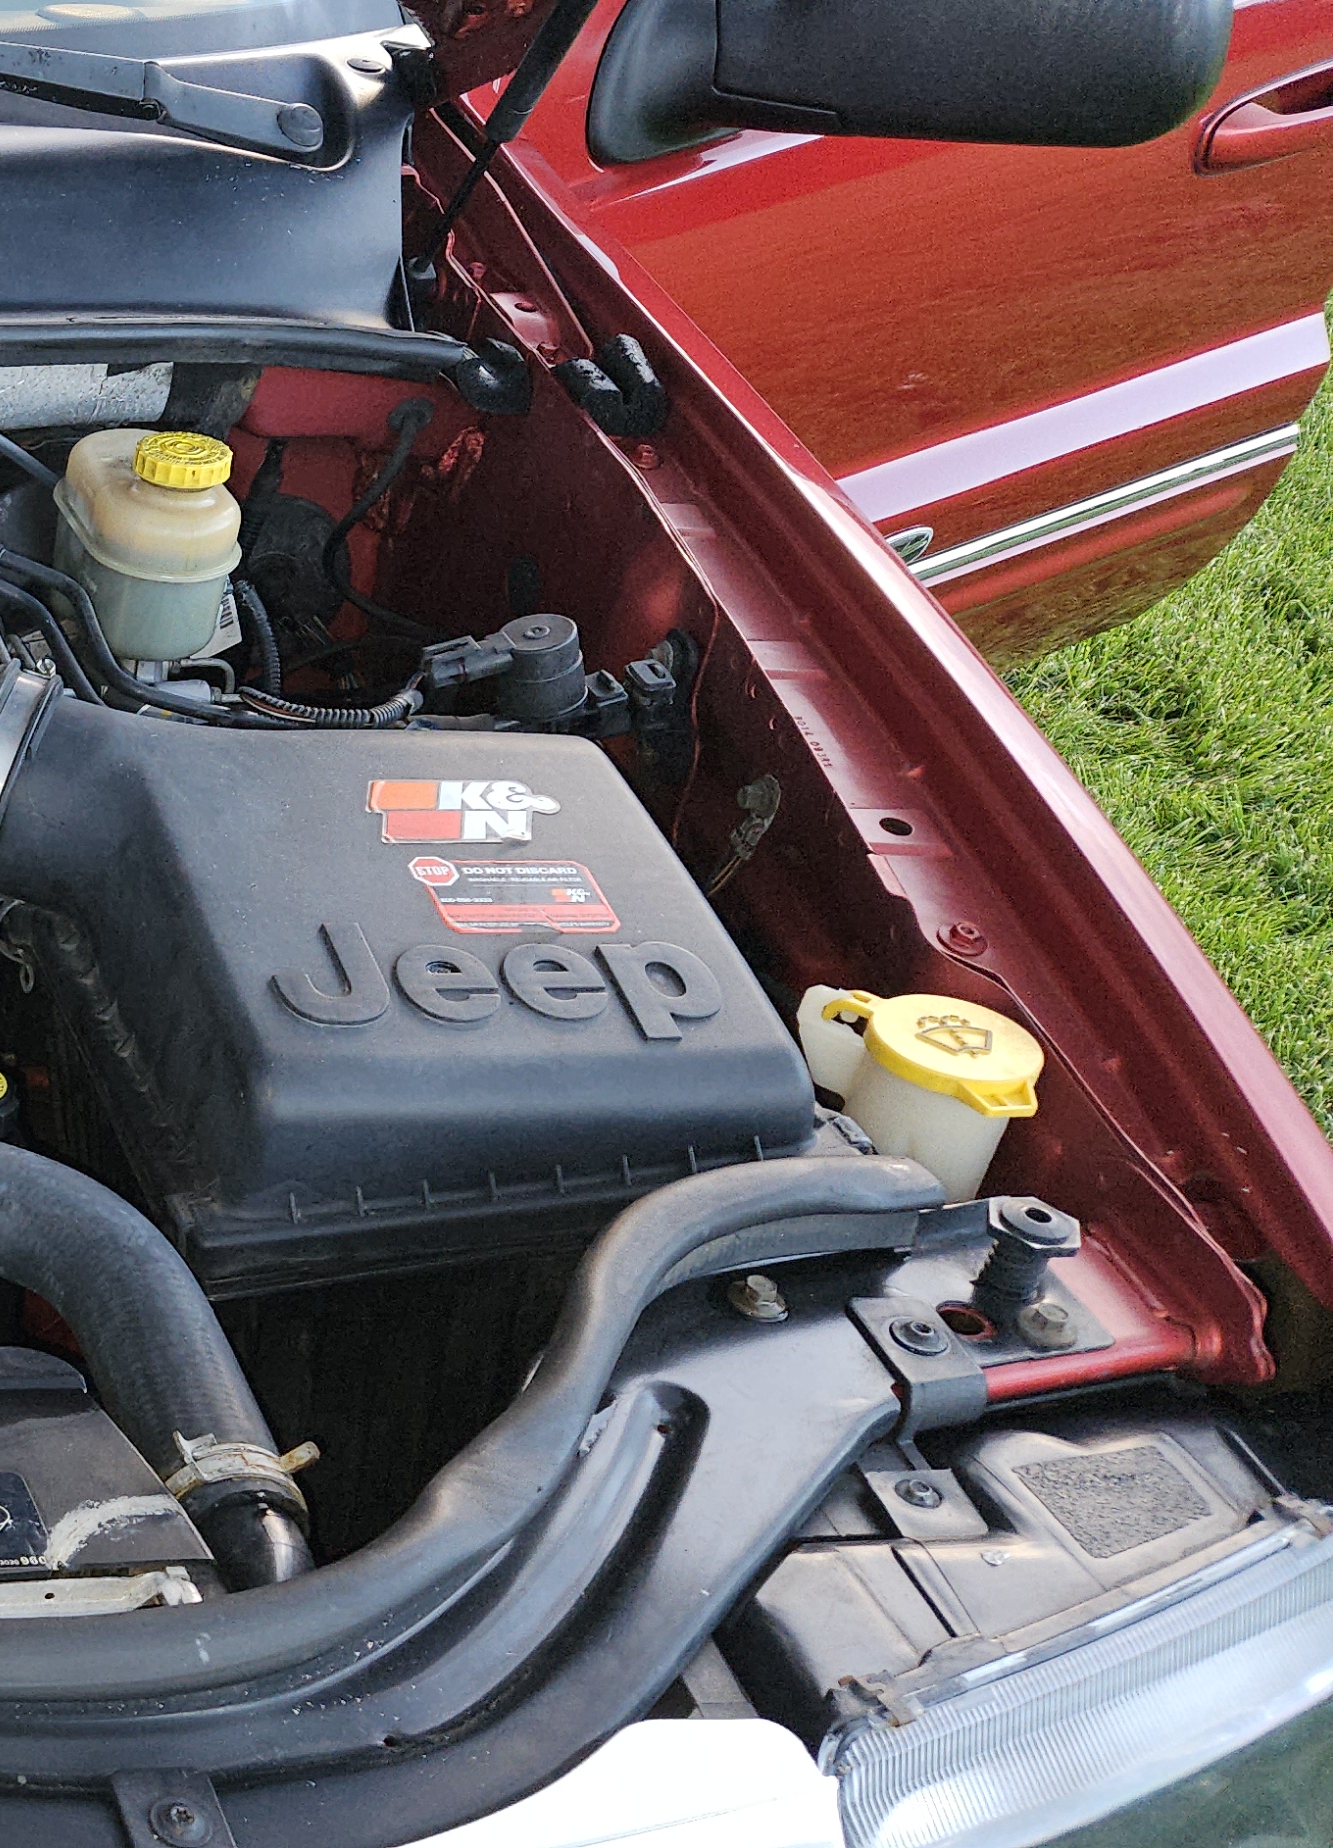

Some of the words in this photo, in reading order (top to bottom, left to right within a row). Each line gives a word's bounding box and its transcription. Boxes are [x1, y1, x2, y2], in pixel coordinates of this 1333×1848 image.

[414, 866, 450, 876] STOP
[461, 867, 484, 875] DO
[485, 867, 514, 875] NOT
[514, 867, 578, 875] DISCARD
[268, 921, 723, 1043] Jeep
